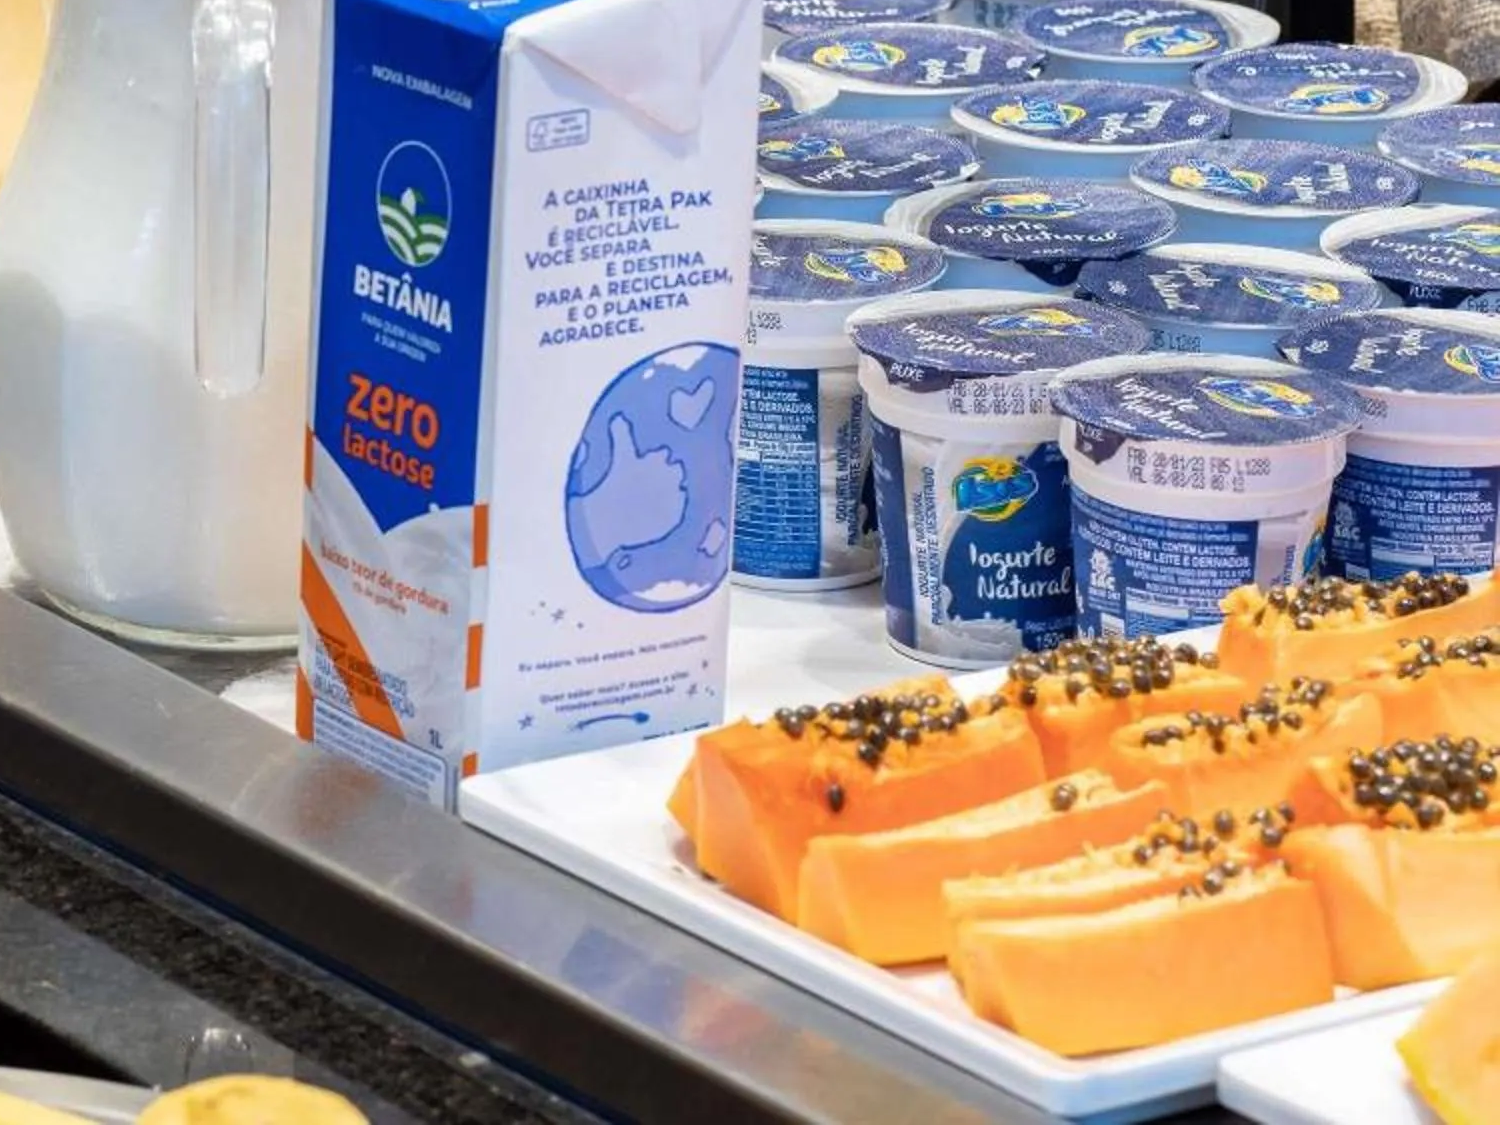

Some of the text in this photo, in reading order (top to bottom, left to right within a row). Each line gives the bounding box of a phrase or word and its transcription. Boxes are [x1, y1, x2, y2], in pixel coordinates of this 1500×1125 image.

[544, 178, 649, 209] A CAIXINHA
[575, 206, 600, 223] DA
[671, 190, 712, 209] PAK
[548, 226, 558, 248] É
[525, 238, 652, 271] VOCÊ SEPARA
[606, 251, 704, 277] E DESTINA
[353, 263, 453, 333] BETÂNIA
[535, 267, 733, 308] PARA A RECICLAGEM,
[567, 292, 689, 322] E O PLANETA
[539, 317, 645, 347] AGRADECE.
[346, 373, 439, 450] zero
[343, 422, 435, 490] lactose
[969, 540, 1056, 581] Iogurte
[977, 566, 1071, 600] Natural
